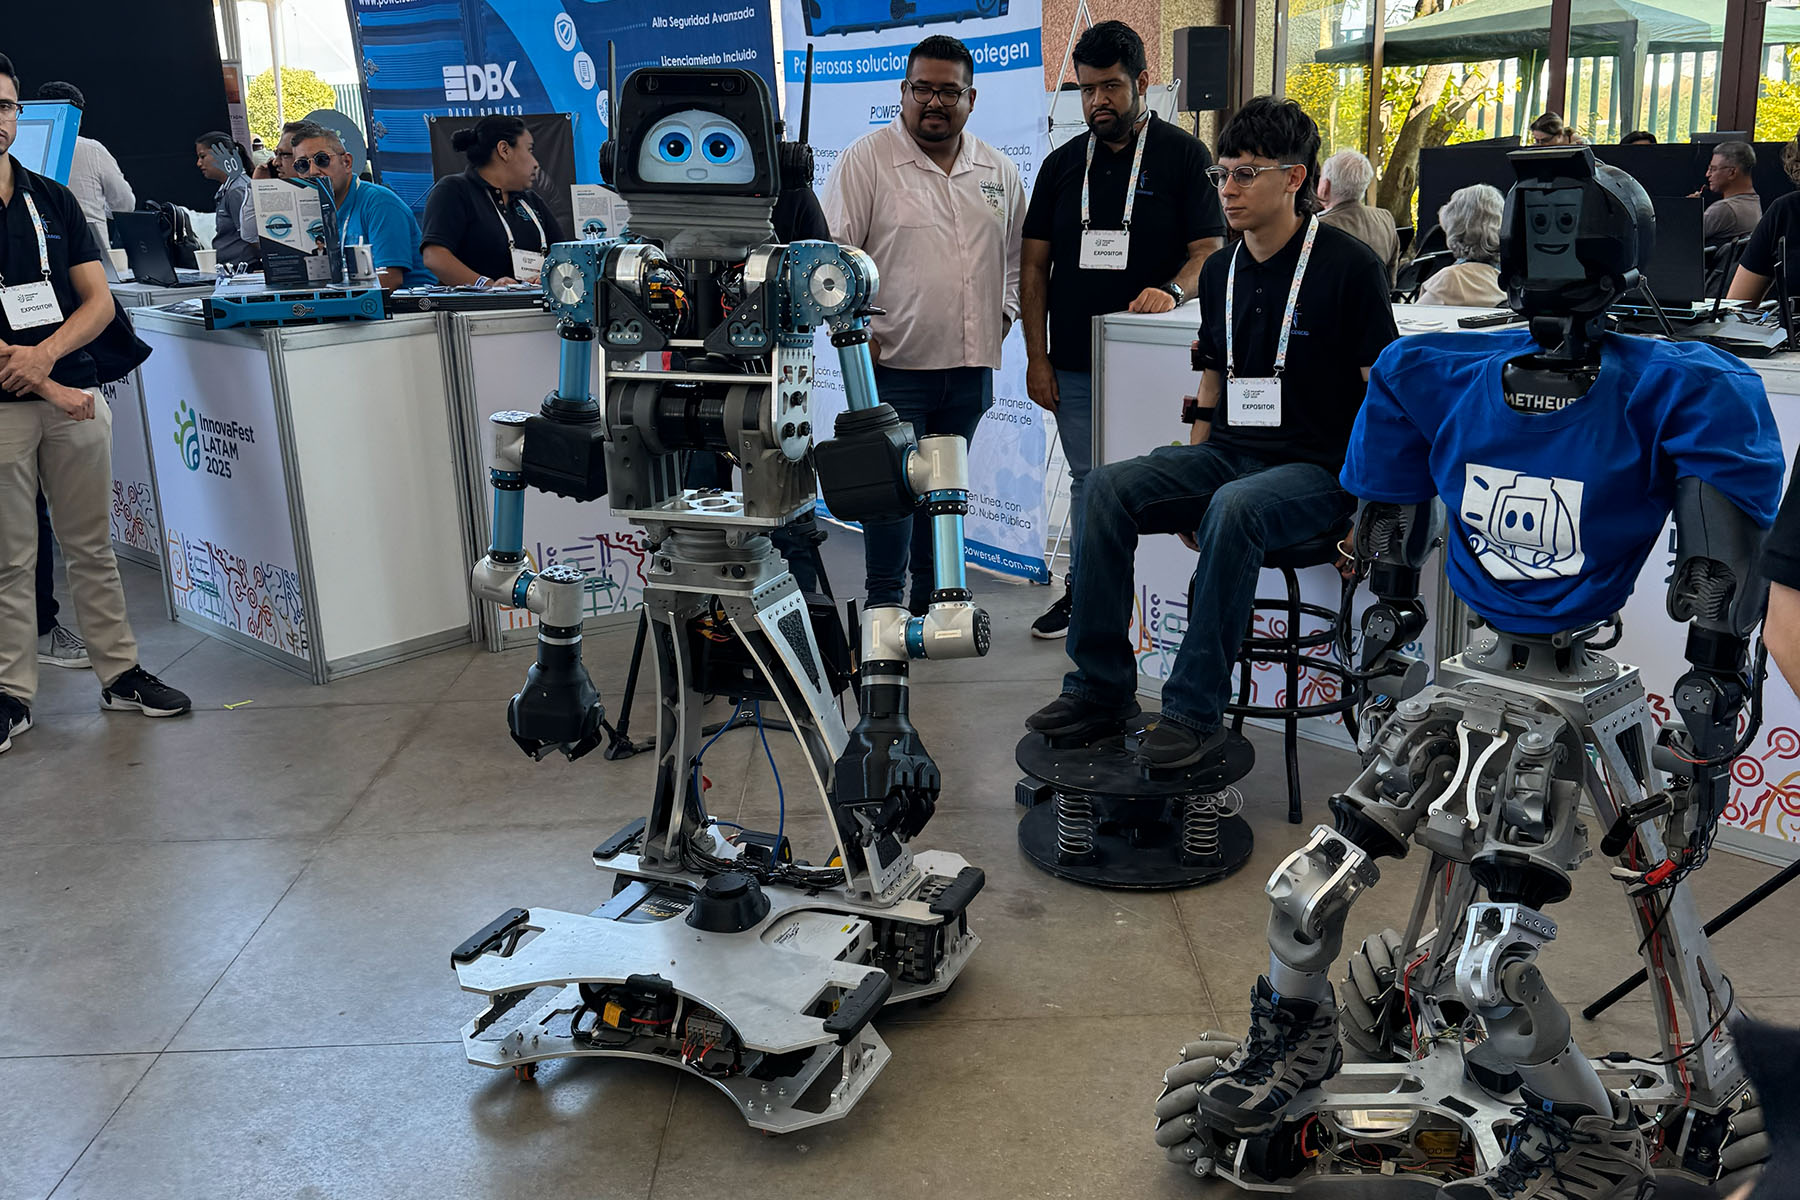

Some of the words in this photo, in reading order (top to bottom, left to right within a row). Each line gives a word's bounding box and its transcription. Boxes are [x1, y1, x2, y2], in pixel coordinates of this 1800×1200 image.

[652, 17, 668, 28] Alta
[669, 13, 710, 29] Seguridad
[712, 6, 755, 24] Avanzada
[661, 52, 722, 67] Licenciamiento
[723, 48, 757, 62] Incluido
[448, 107, 473, 117] DATA
[480, 104, 523, 117] BUNKER
[223, 158, 239, 173] GO
[1023, 160, 1031, 172] la
[20, 303, 53, 314] EXPOSITOR
[100, 383, 117, 400] AM
[999, 397, 1033, 410] manera
[985, 411, 1017, 424] usuarios
[1020, 414, 1032, 425] de
[199, 413, 255, 443] InnovaFest
[201, 434, 239, 460] LATAM
[205, 456, 232, 479] 2025
[1004, 501, 1022, 512] con
[979, 508, 1000, 521] Nube
